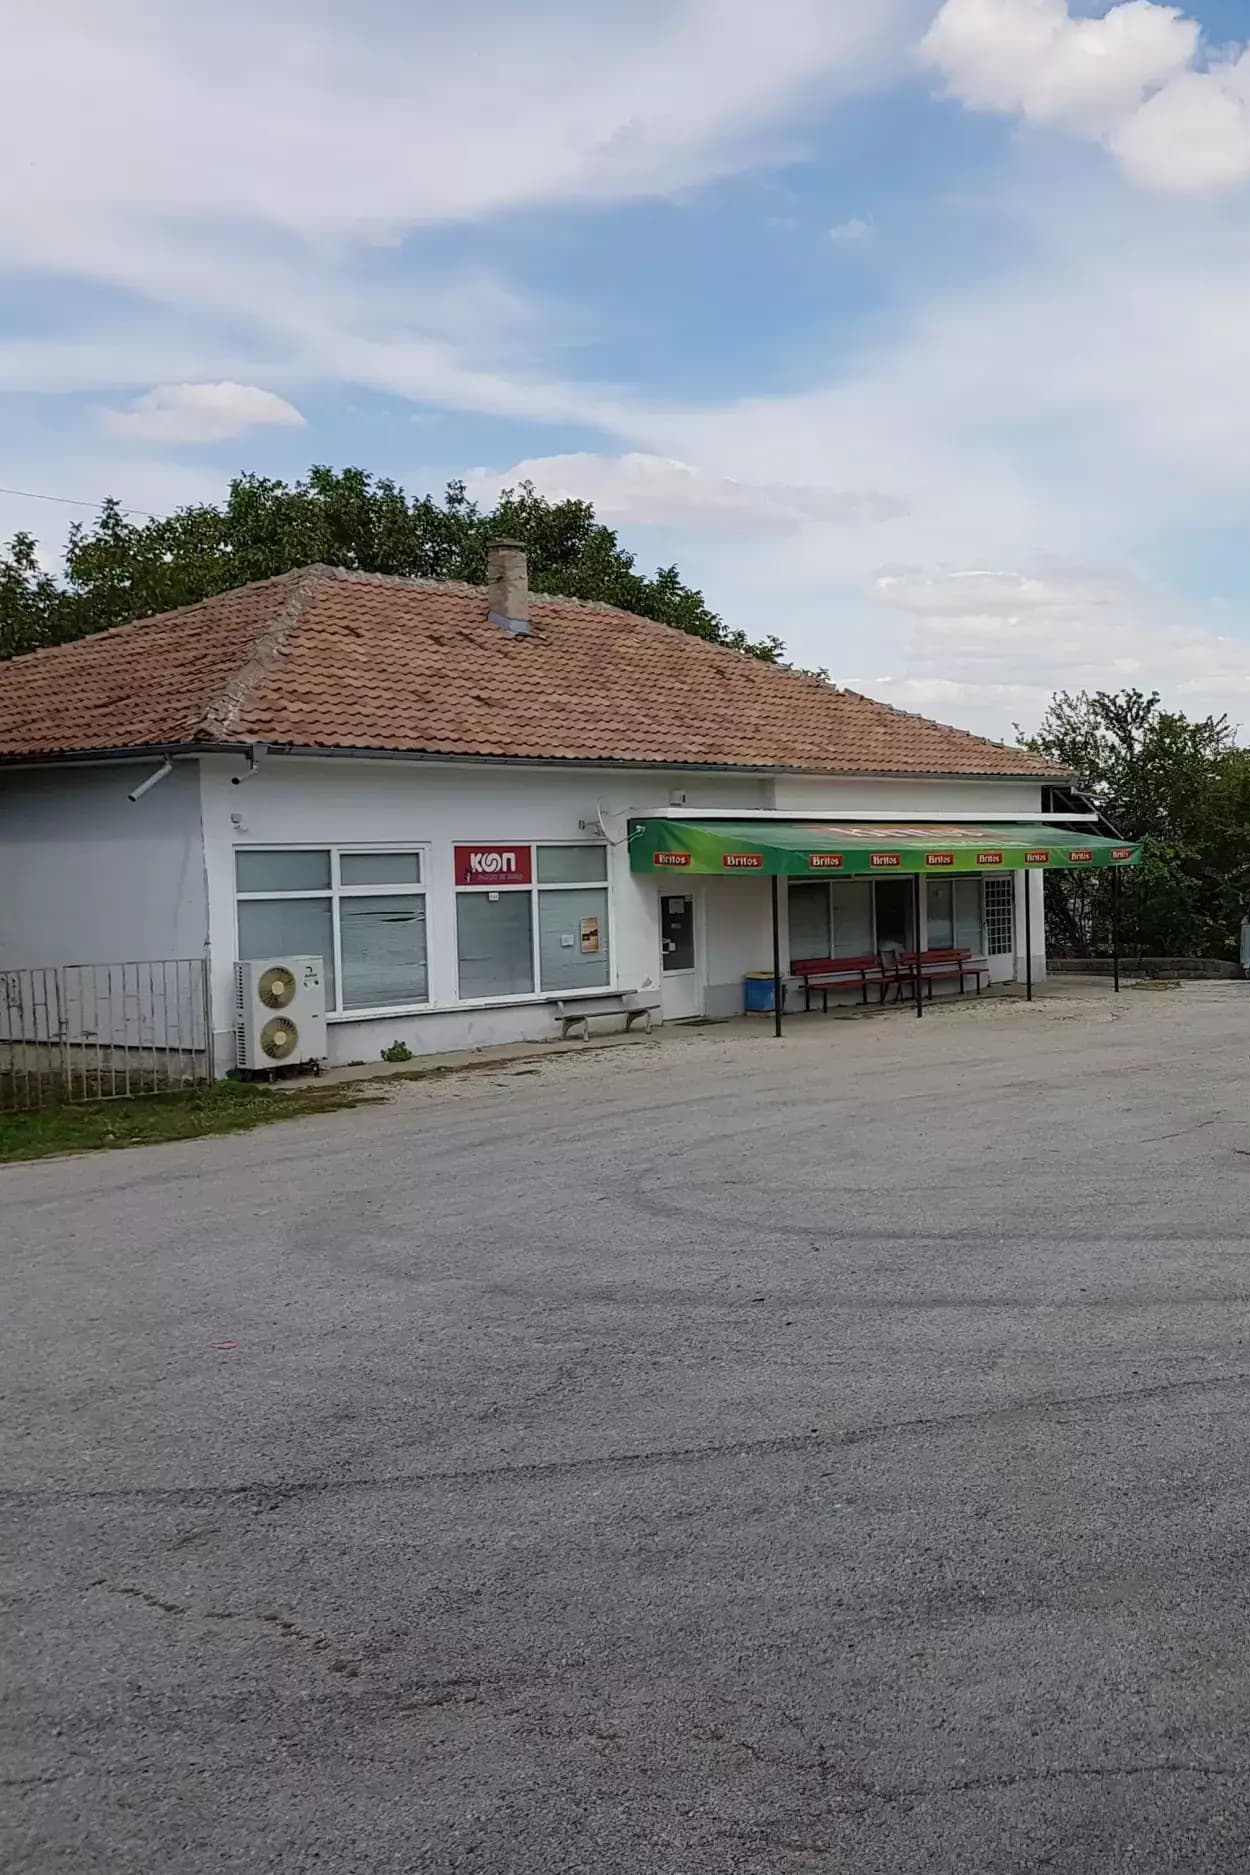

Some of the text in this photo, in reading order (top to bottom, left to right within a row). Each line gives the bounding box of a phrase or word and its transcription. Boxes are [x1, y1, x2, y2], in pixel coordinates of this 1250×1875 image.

[813, 856, 839, 866] Britos
[873, 856, 897, 865] Britos
[928, 855, 951, 865] Britos
